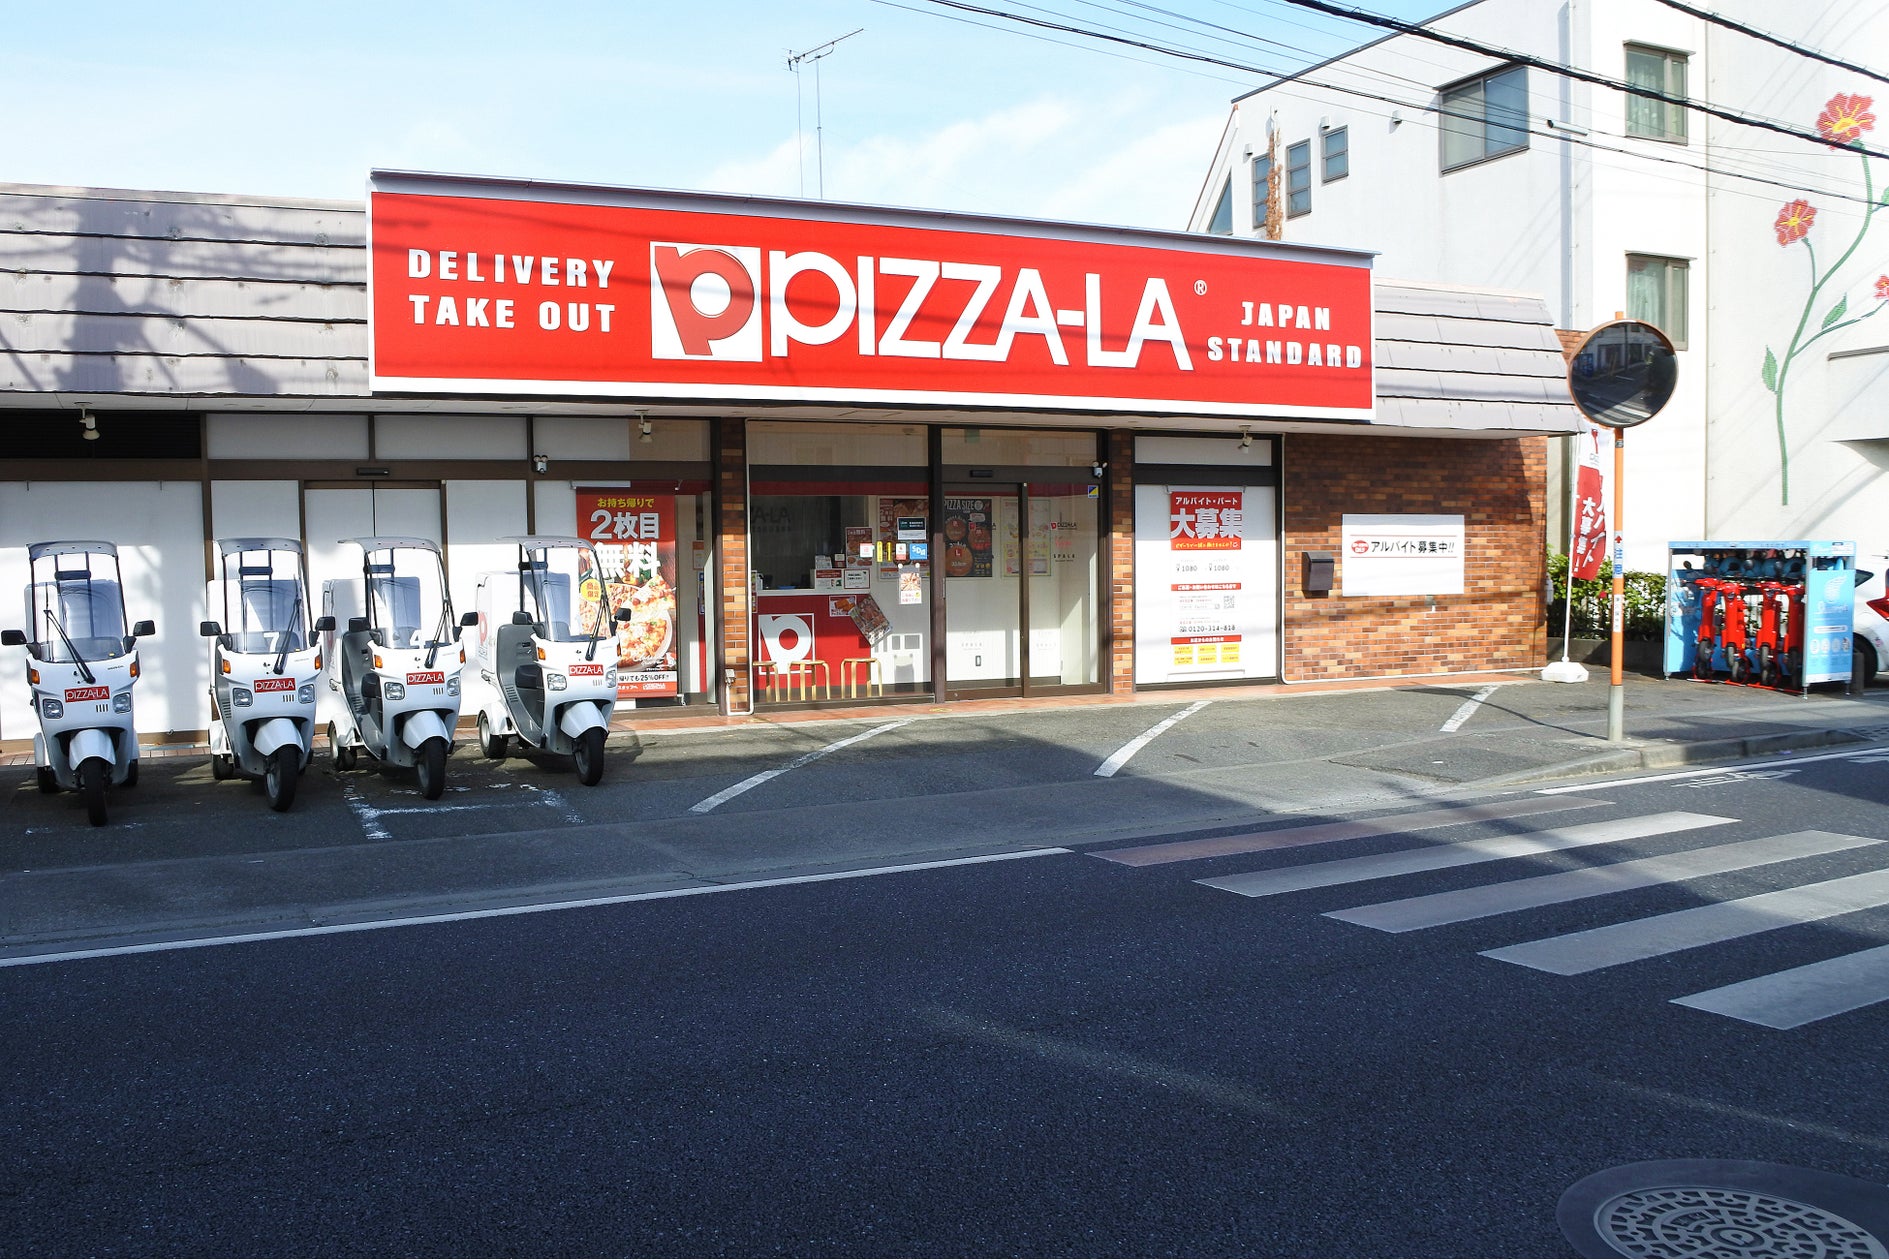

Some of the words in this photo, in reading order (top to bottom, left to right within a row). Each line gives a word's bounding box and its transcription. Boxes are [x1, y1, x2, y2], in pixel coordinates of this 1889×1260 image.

[407, 248, 615, 289] DELIVERY
[408, 294, 515, 329] TAKE
[538, 300, 615, 333] OUT
[1241, 300, 1331, 332] JAPAN
[1207, 336, 1362, 369] STANDARD
[597, 497, 655, 508] お持ち帰りで
[1174, 496, 1238, 505] アルバイト・パート
[590, 509, 660, 540] 2枚目
[1170, 508, 1242, 539] 大募集
[590, 541, 661, 579] 無料
[263, 631, 280, 652] 7
